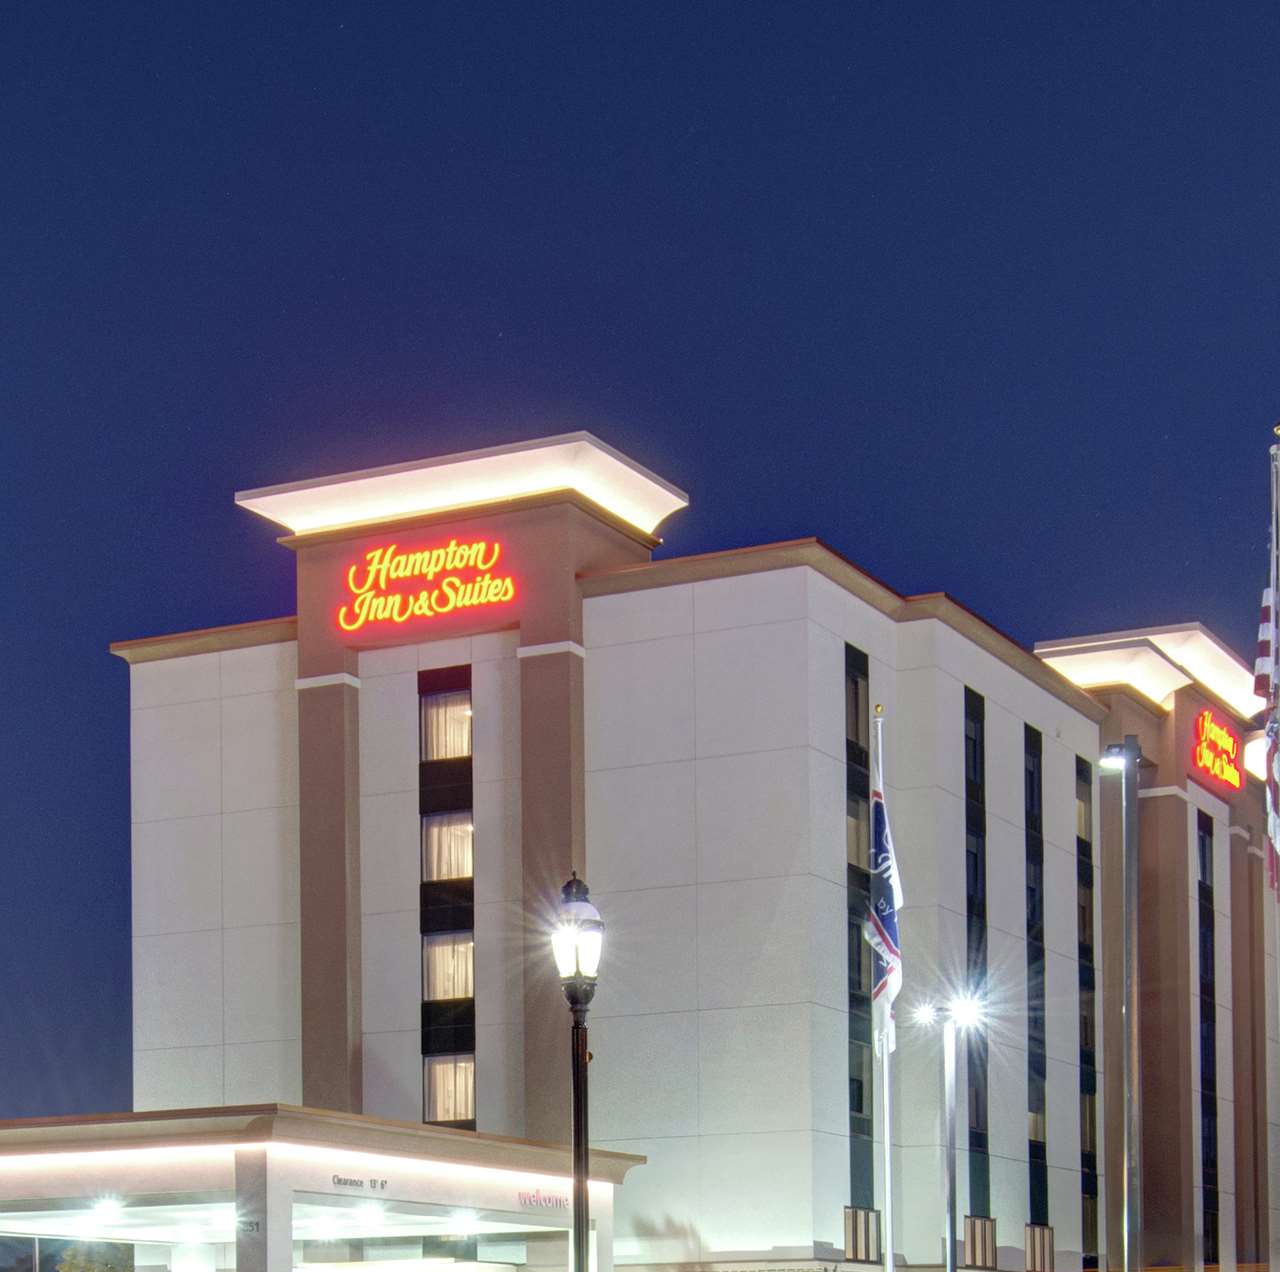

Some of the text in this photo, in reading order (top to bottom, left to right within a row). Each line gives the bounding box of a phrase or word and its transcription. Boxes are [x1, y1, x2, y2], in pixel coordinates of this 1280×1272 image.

[348, 539, 500, 594] Hampton
[338, 573, 515, 631] Inn & Suites
[332, 1174, 365, 1187] Clearance
[518, 1188, 570, 1209] welcome
